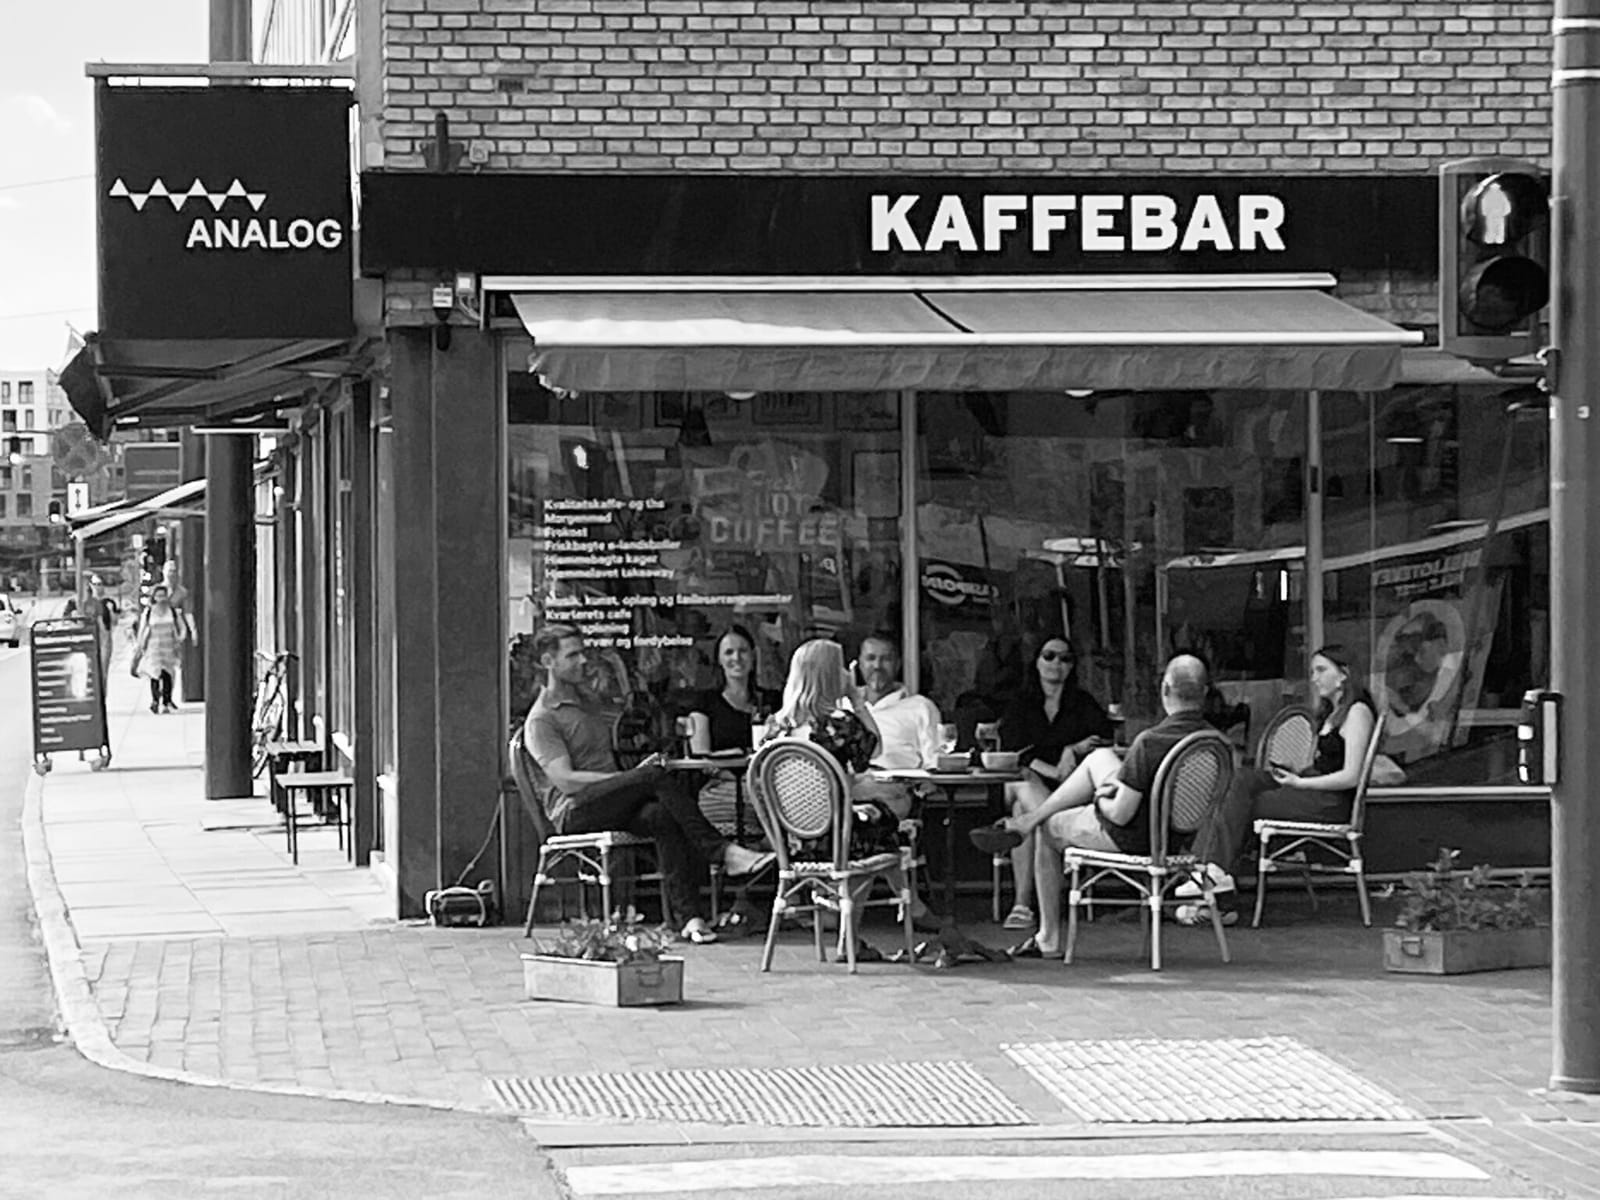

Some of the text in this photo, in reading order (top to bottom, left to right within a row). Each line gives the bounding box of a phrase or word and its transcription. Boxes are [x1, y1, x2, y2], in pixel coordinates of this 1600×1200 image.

[871, 195, 1286, 251] KAFFEBAR
[186, 218, 342, 248] ANALOG
[628, 500, 643, 511] og
[544, 527, 588, 538] Frokost
[625, 553, 658, 566] kager
[659, 596, 674, 607] og
[545, 609, 605, 620] Kvarterets
